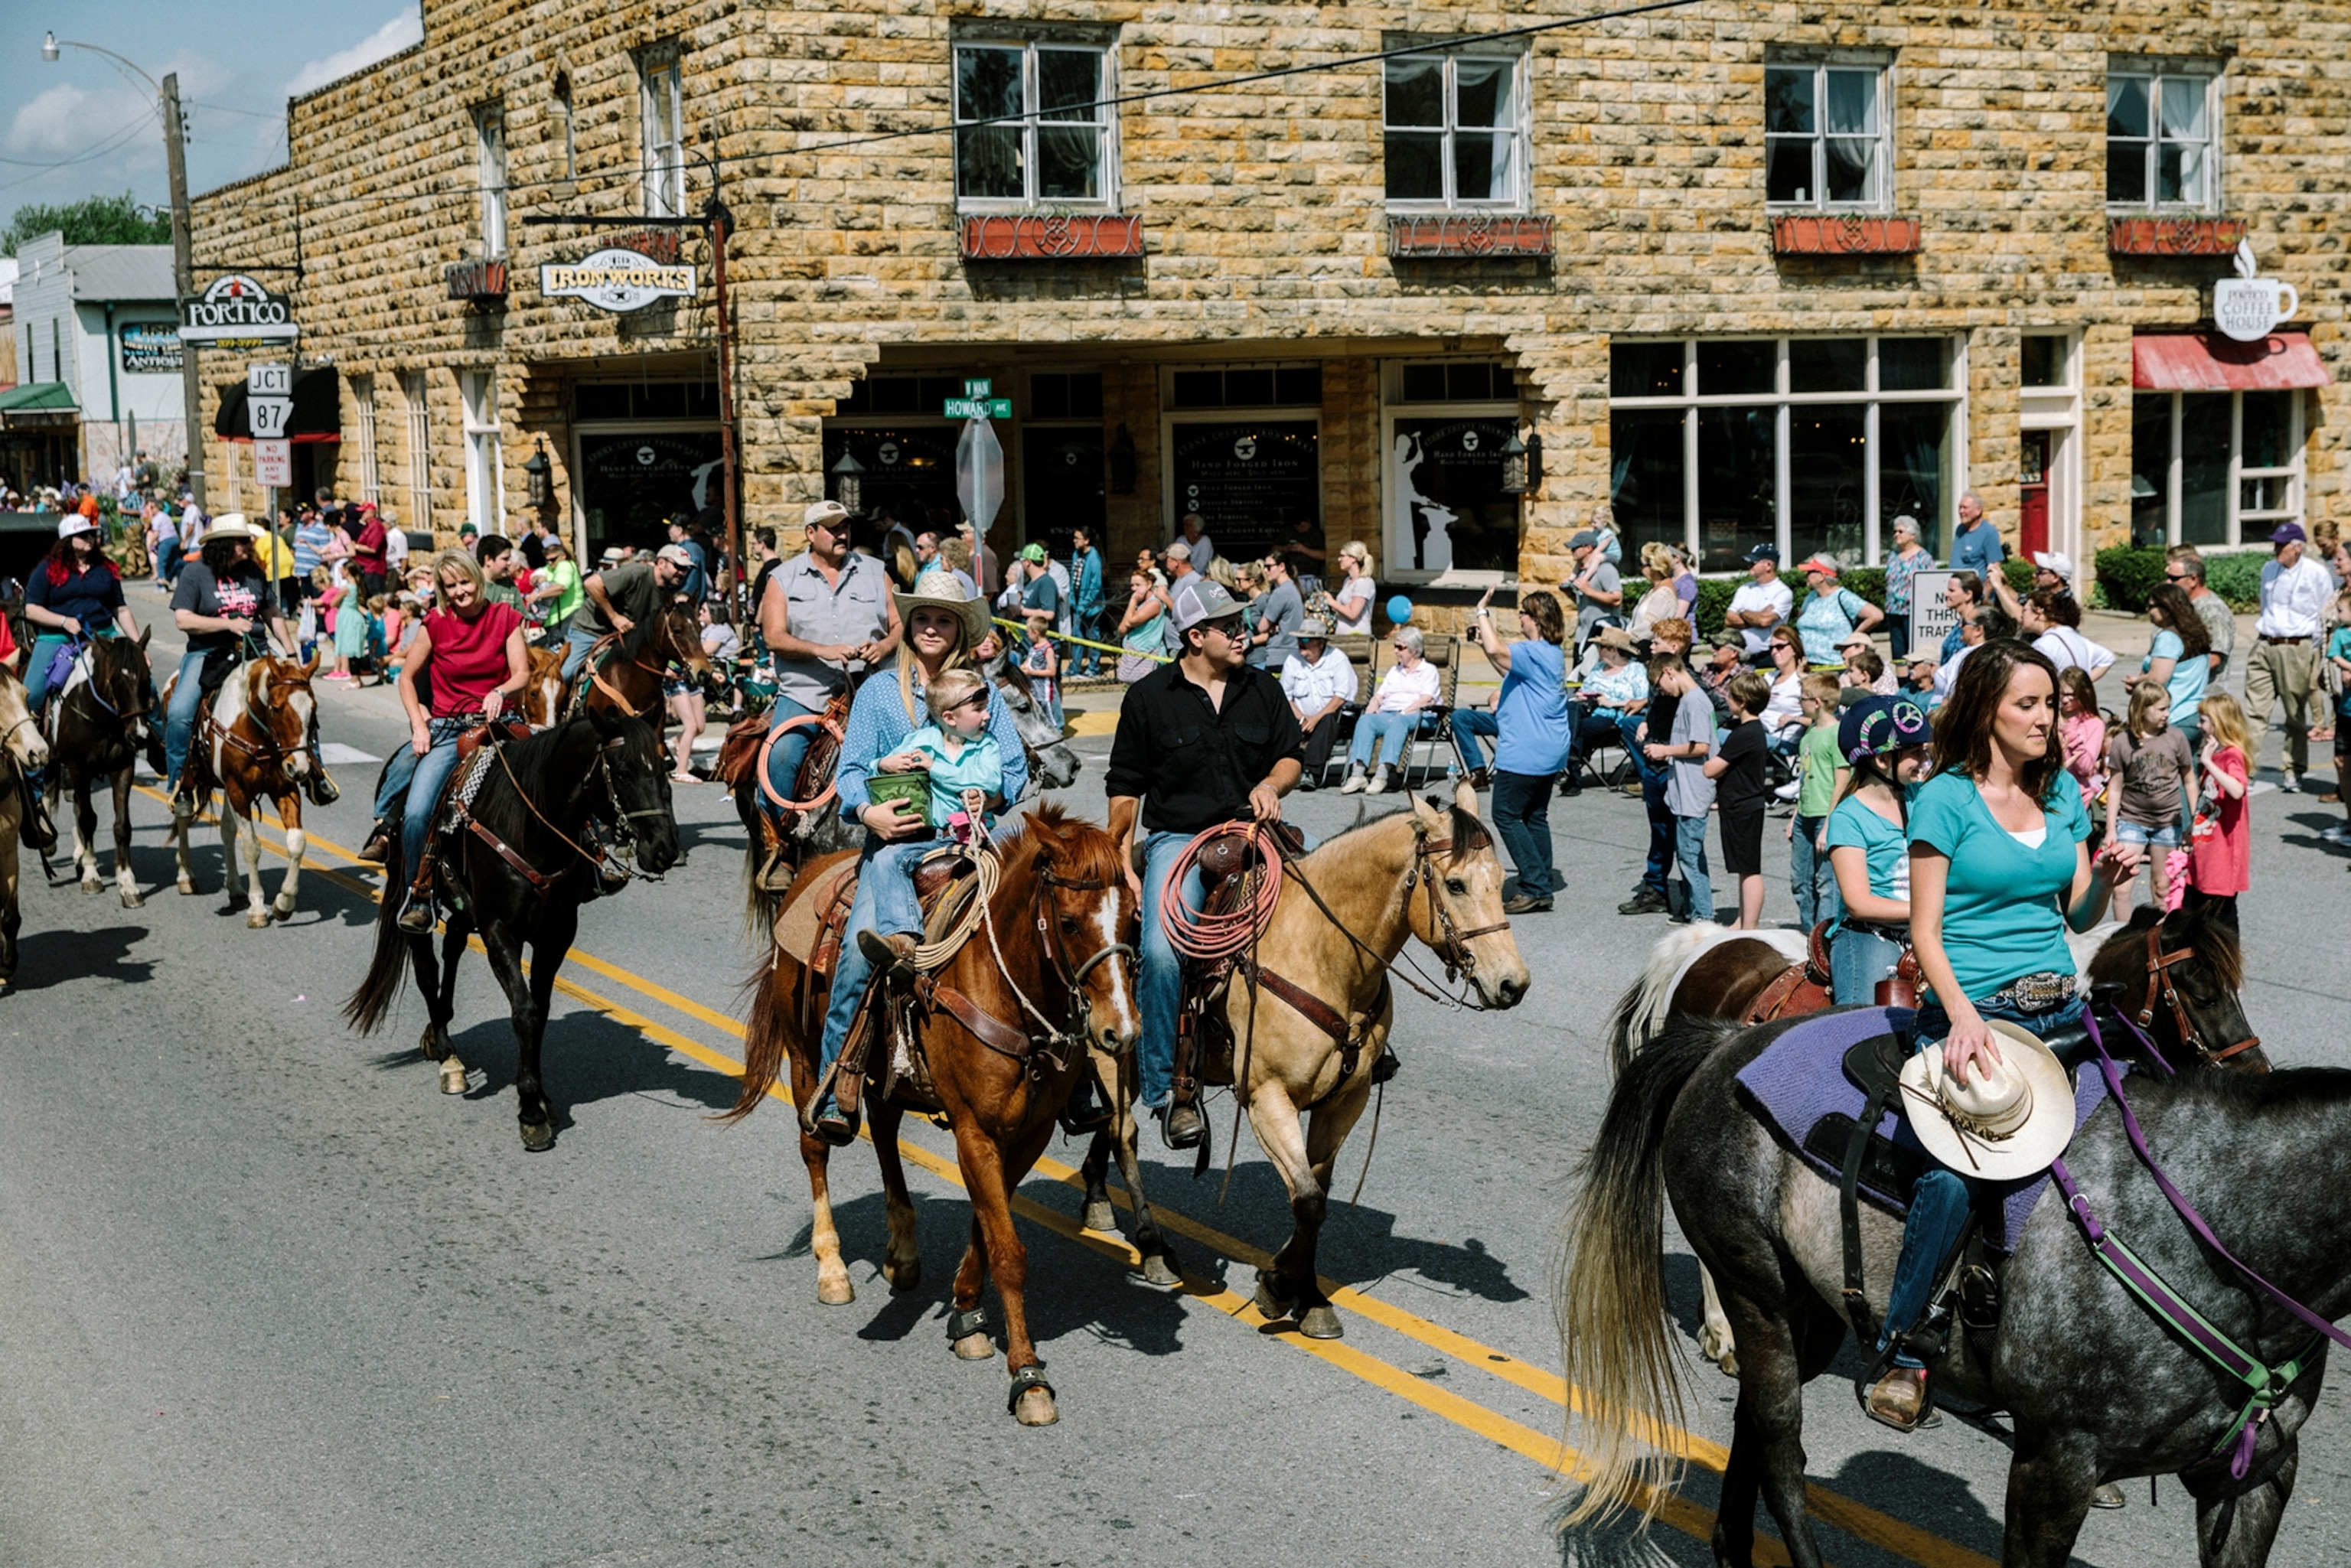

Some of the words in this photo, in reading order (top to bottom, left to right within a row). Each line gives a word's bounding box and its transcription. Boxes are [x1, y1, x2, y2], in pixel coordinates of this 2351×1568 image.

[549, 269, 690, 291] IRONWORKS
[189, 302, 285, 327] PORTICO
[2222, 302, 2273, 315] COFFEE
[2225, 316, 2269, 329] HOUSE
[253, 370, 285, 389] JCT
[947, 401, 991, 416] HOWARD
[996, 403, 1007, 412] AVE
[257, 405, 281, 429] 87
[266, 445, 277, 454] NO
[259, 455, 285, 464] PARKING
[1935, 592, 1947, 604] N
